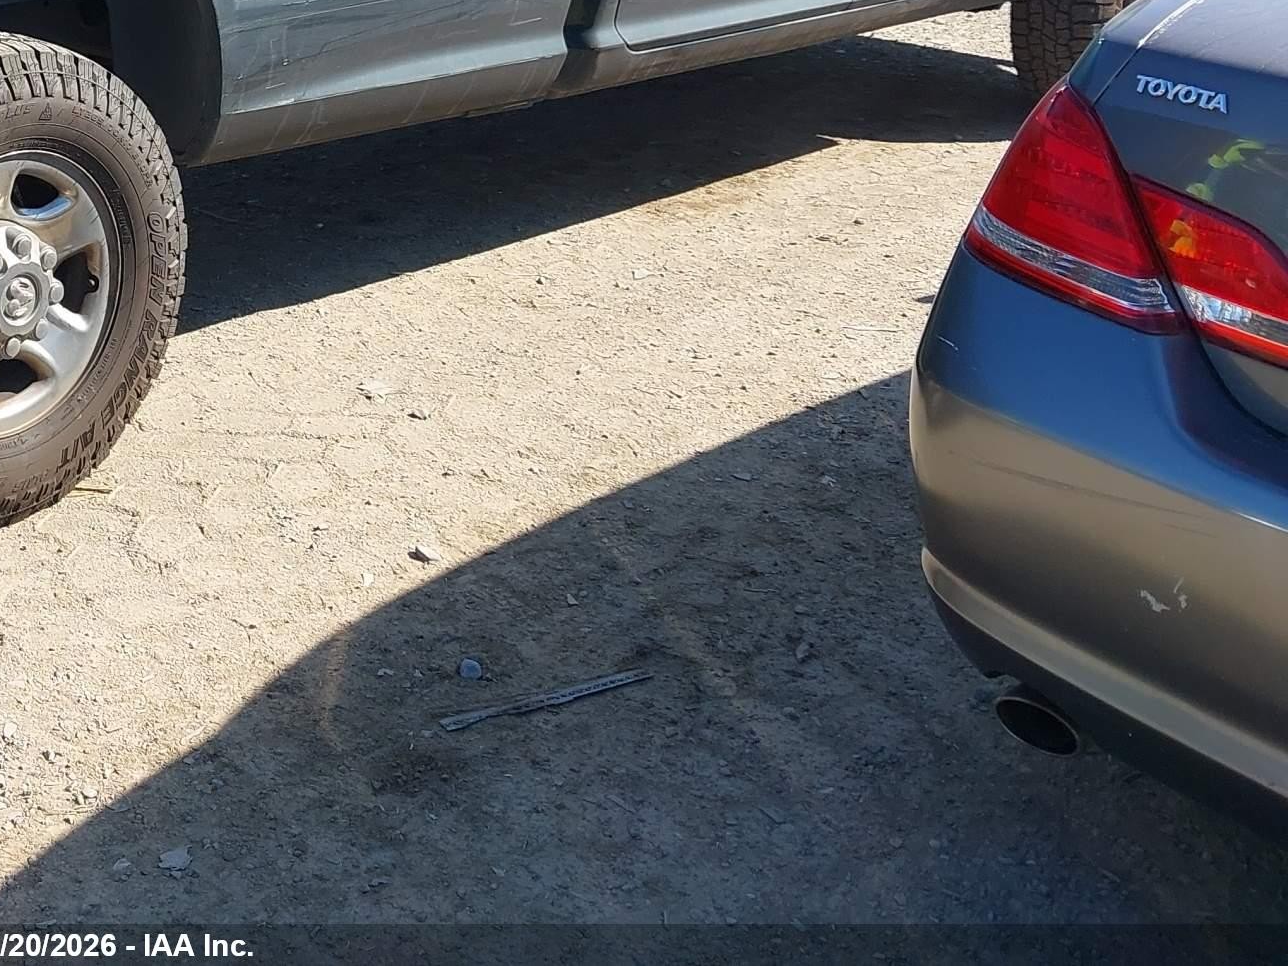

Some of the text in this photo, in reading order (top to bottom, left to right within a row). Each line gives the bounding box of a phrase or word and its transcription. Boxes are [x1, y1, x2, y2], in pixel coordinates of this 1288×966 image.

[1136, 74, 1228, 115] TOYOTA
[148, 211, 167, 306] OPEN
[101, 309, 159, 430] RANGE
